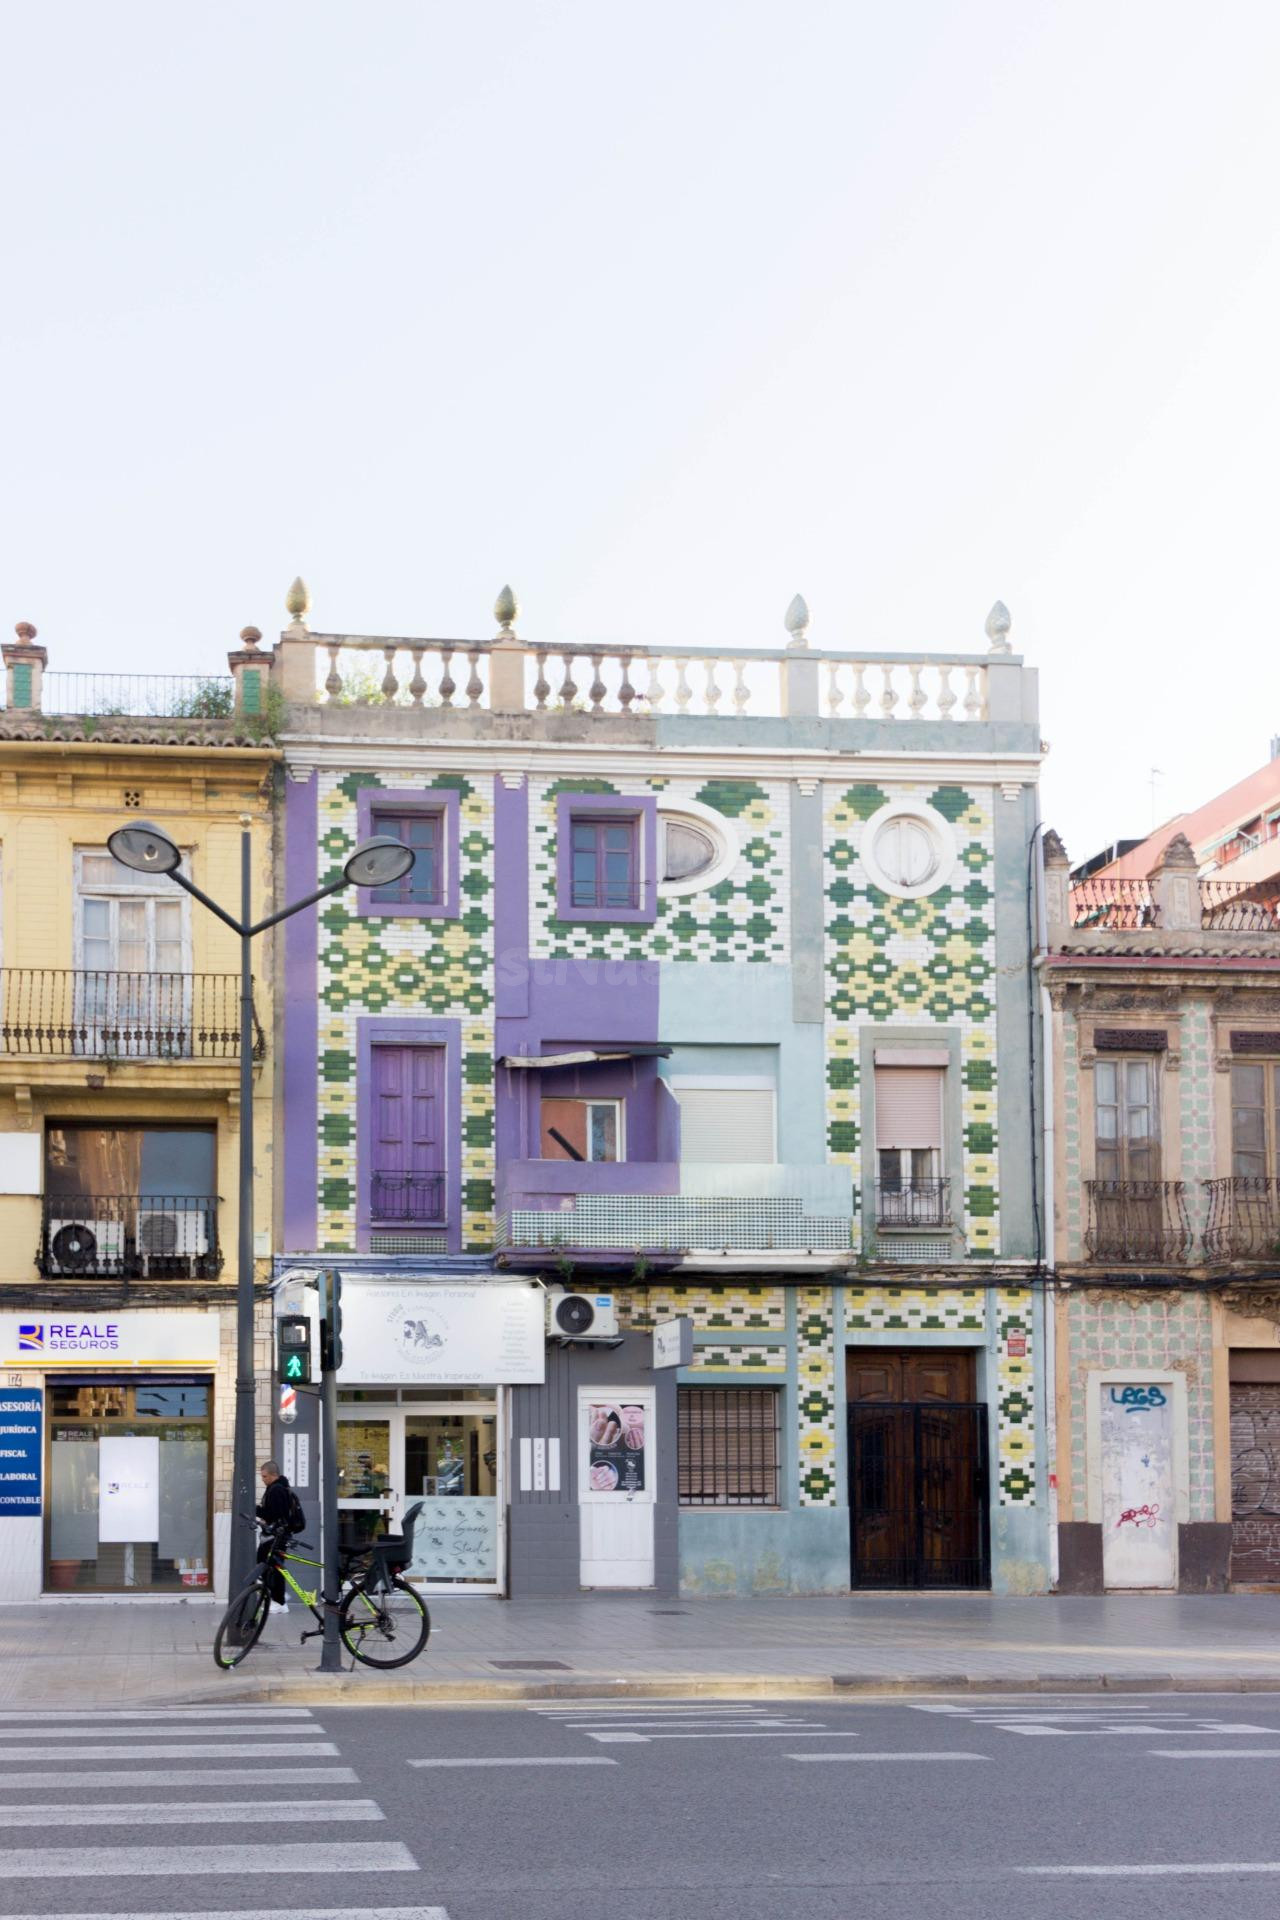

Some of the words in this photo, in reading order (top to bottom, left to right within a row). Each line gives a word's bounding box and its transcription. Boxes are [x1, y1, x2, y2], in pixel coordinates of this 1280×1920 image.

[50, 1325, 119, 1338] REALE
[50, 1340, 119, 1350] SEGUROS
[0, 1496, 41, 1504] CONTABLE
